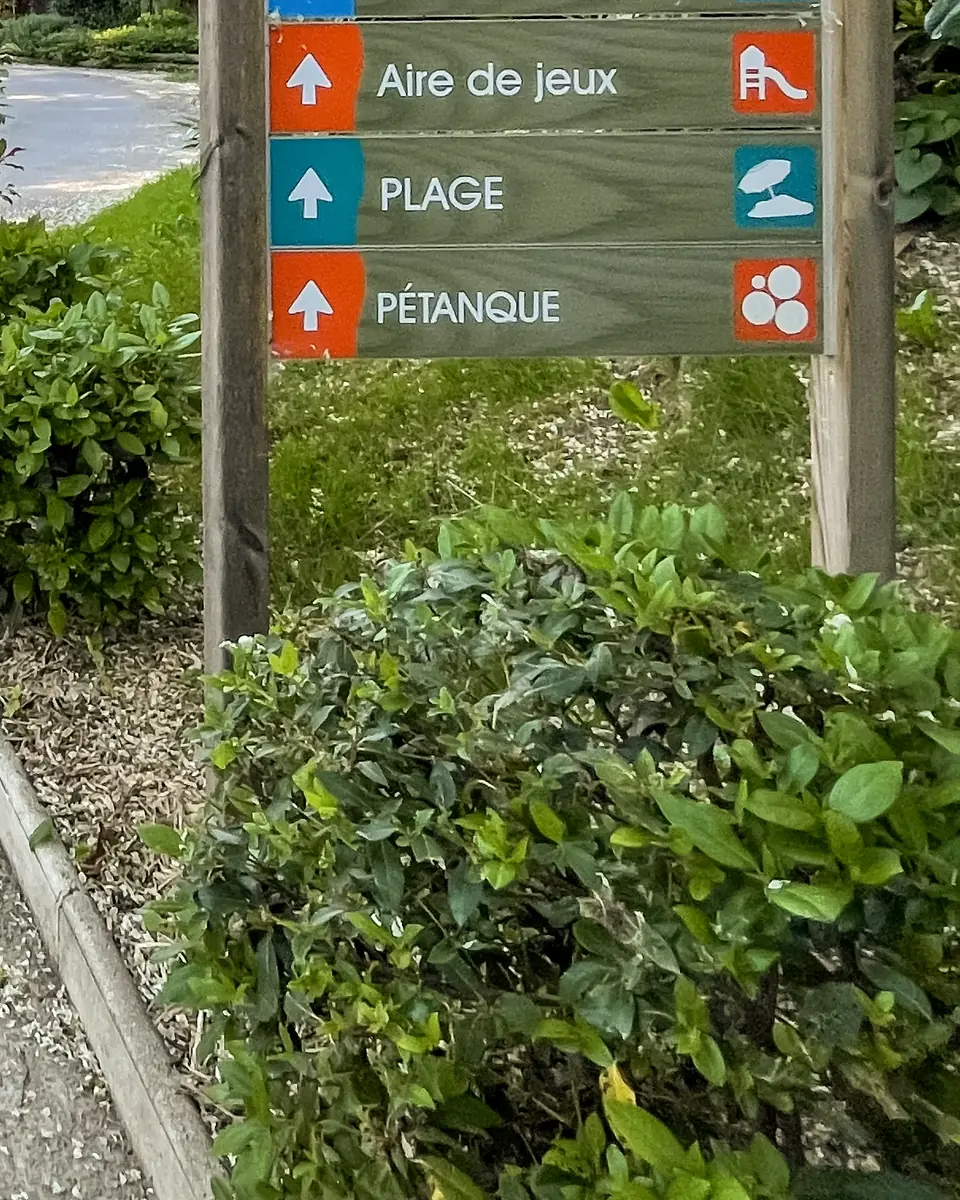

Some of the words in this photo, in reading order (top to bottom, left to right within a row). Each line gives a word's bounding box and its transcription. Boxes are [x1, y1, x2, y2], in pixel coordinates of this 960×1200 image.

[376, 63, 454, 97] Aire
[467, 62, 523, 97] de
[534, 62, 618, 103] jeux
[381, 176, 504, 211] PLAGE
[377, 282, 560, 324] PÉTANQUE
